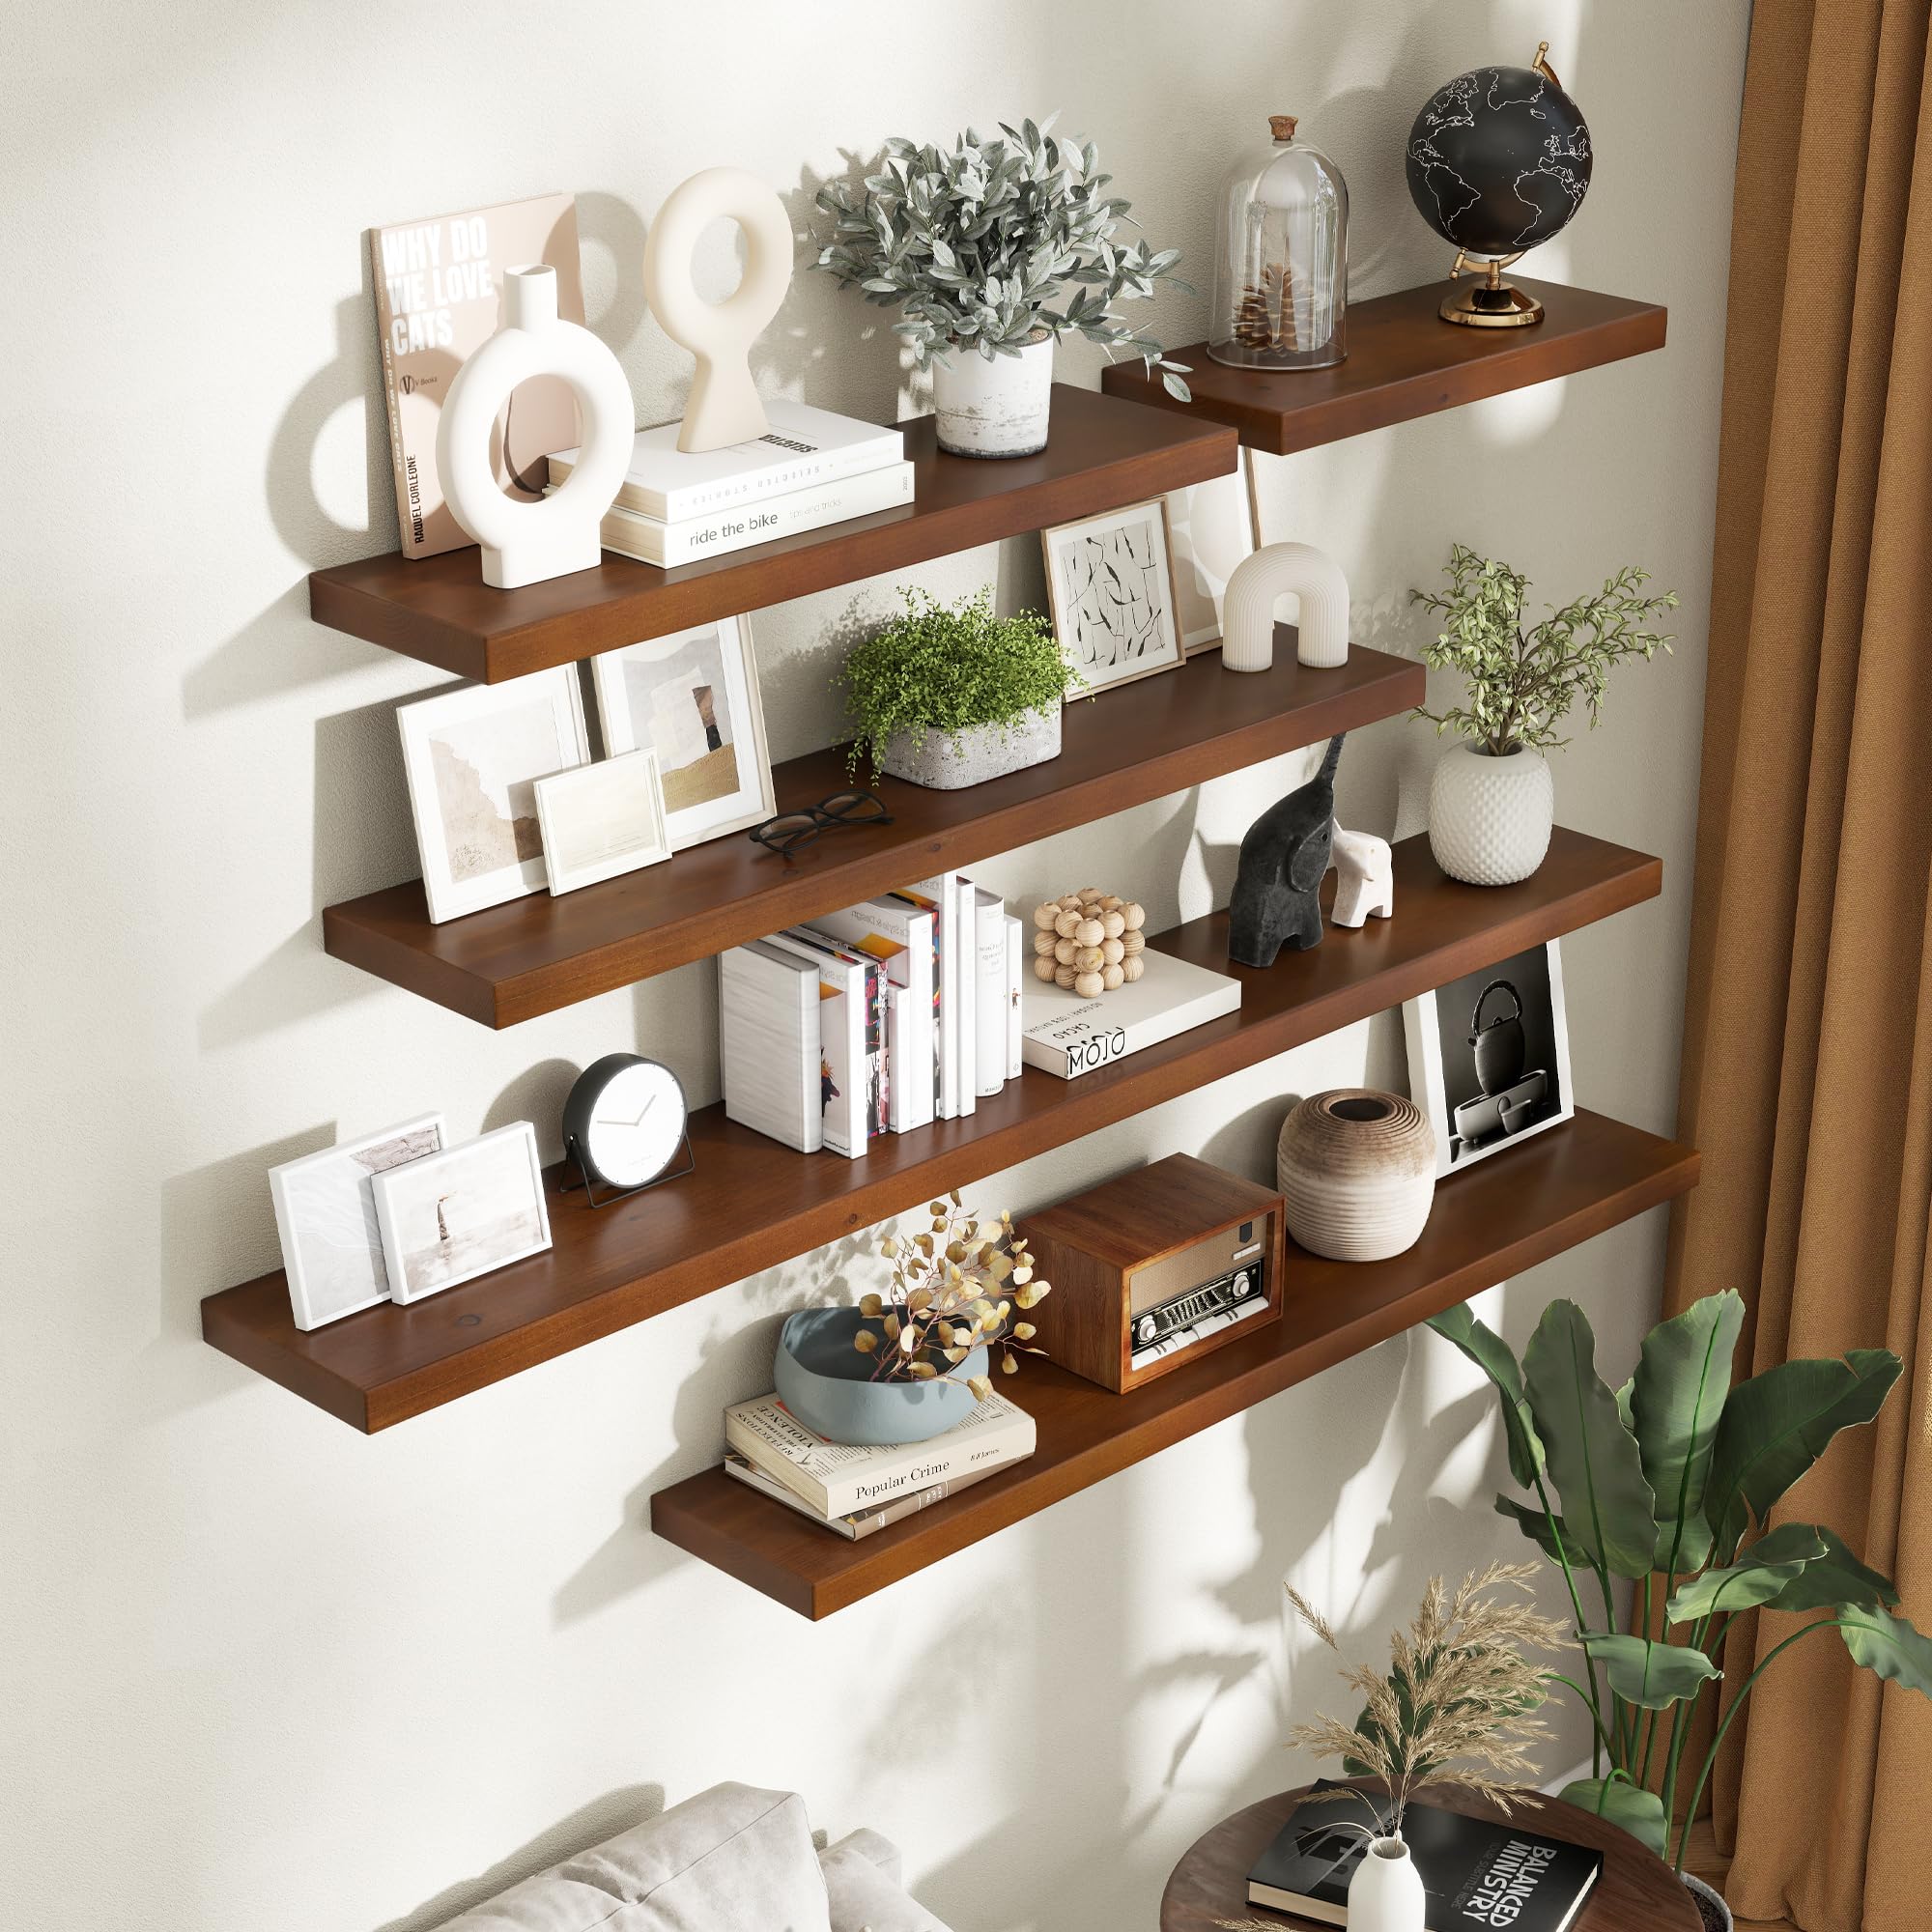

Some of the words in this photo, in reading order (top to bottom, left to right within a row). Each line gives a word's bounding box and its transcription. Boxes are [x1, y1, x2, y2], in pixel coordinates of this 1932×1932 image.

[381, 223, 441, 275] WHY
[450, 215, 487, 260] DO
[386, 271, 428, 316] WE
[434, 260, 494, 306] LOVE
[391, 310, 453, 356] CATS
[758, 434, 818, 453] SELECTED
[407, 454, 420, 504] CORLEONE
[412, 505, 425, 544] RAQUEL
[690, 530, 718, 546] ride
[722, 523, 745, 537] the
[750, 513, 779, 529] bike
[1053, 1023, 1090, 1039] CACAO
[1068, 1031, 1125, 1075] MOJO
[735, 1412, 793, 1456] REFLECTIONS
[756, 1406, 813, 1448] VIOLENCE
[855, 1476, 907, 1500] Popular
[910, 1461, 950, 1482] Crime
[1462, 1839, 1532, 1922] MINISTRY
[1490, 1846, 1558, 1927] BALANCED
